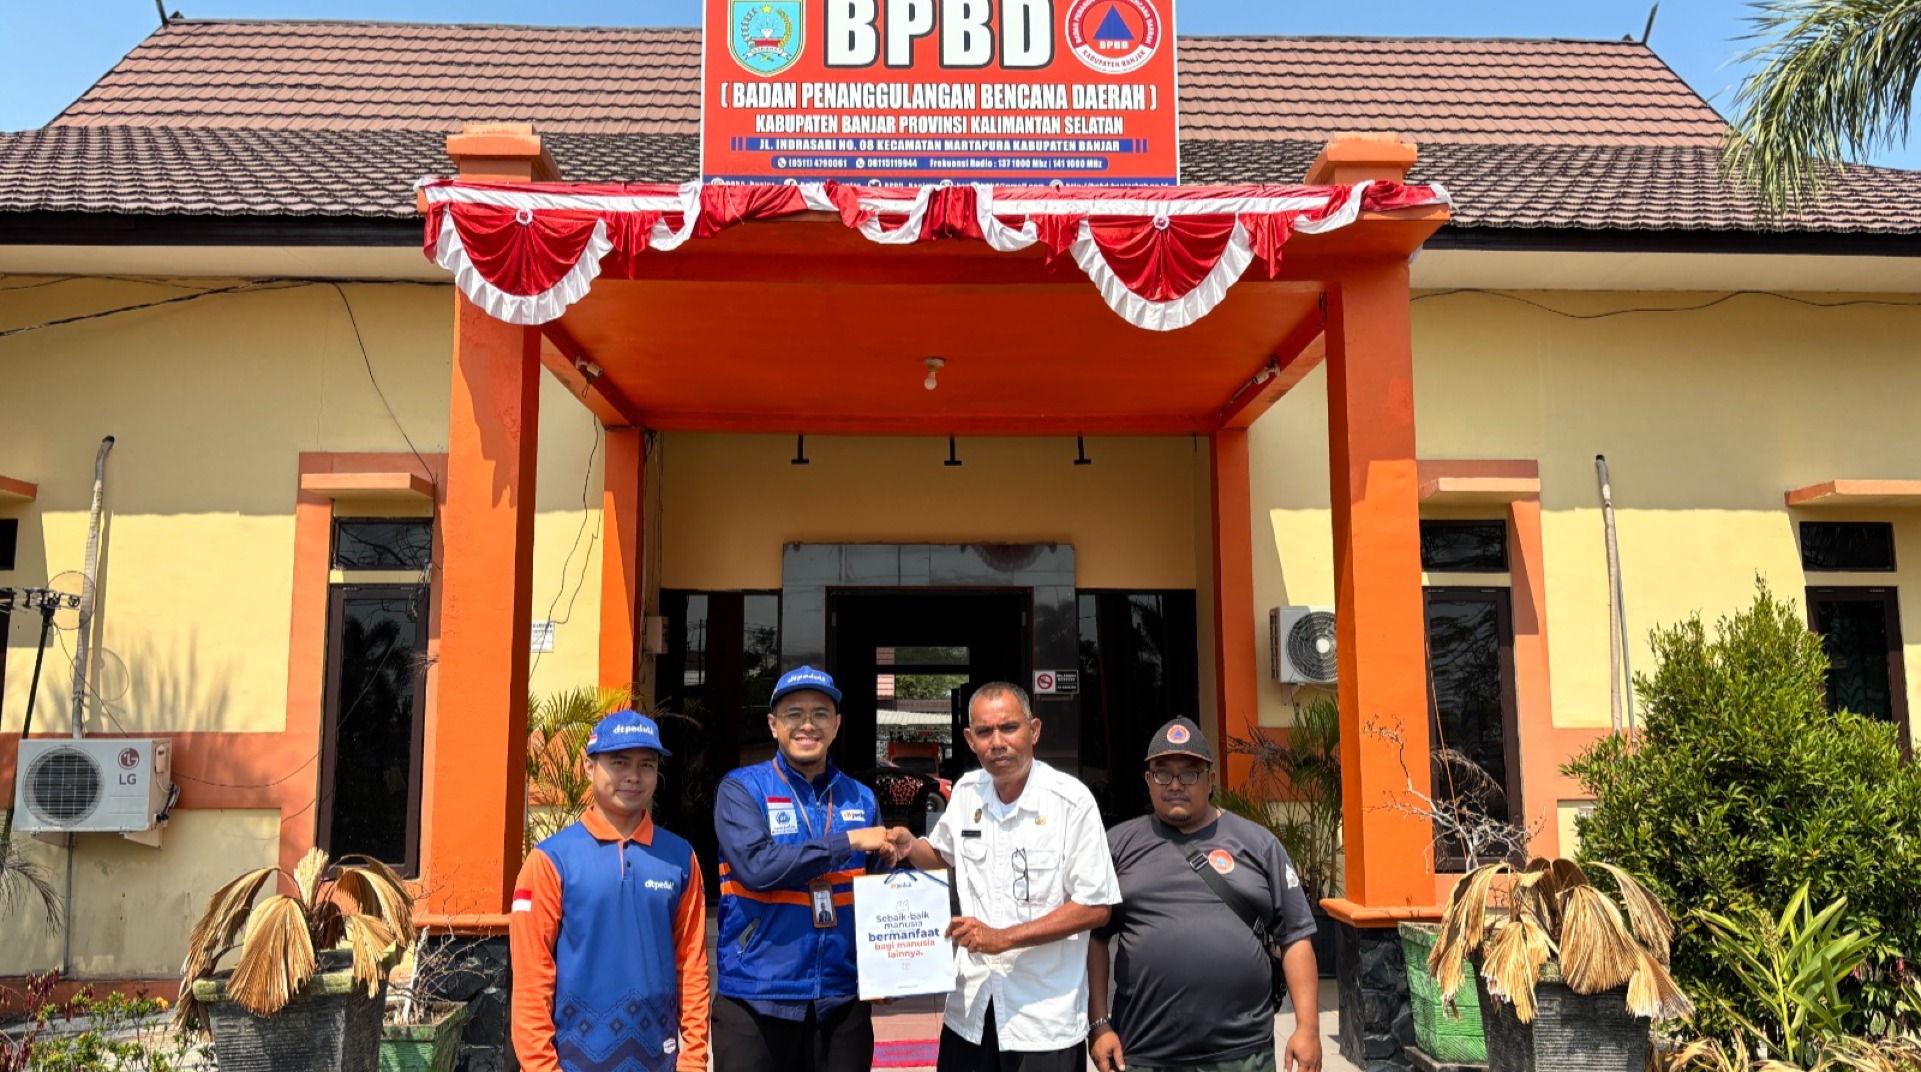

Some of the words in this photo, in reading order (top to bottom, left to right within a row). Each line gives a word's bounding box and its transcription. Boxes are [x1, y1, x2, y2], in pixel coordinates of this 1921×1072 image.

[824, 0, 1054, 69] BPBD
[1099, 40, 1129, 50] BPBD
[1082, 49, 1120, 68] KABUPATEN
[1121, 49, 1146, 68] BANJAR
[732, 82, 797, 109] BADAN
[800, 82, 976, 110] PENANGGULANGAN
[980, 83, 1068, 110] BENCANA
[1072, 84, 1145, 110] DAERAH
[755, 114, 838, 133] KABUPATEN
[841, 115, 896, 133] BANJAR
[899, 115, 967, 134] PROVINSI
[971, 116, 1061, 134] KALIMANTAN
[1065, 116, 1124, 134] SELATAN
[759, 138, 774, 151] JL.
[776, 138, 837, 151] INDRASARI
[838, 139, 857, 151] NO.
[860, 139, 874, 151] 08
[877, 139, 942, 151] KECAMATAN
[944, 139, 1011, 152] MARTAPURA
[1013, 140, 1077, 152] KABUPATEN
[1079, 140, 1120, 152] BANJAR
[930, 158, 969, 168] Frekuensi
[970, 158, 993, 168] Radio
[119, 773, 137, 785] LG
[884, 920, 923, 929] manusia
[868, 928, 940, 942] bermanfaat
[875, 940, 895, 951] bagi
[897, 938, 935, 948] manusia
